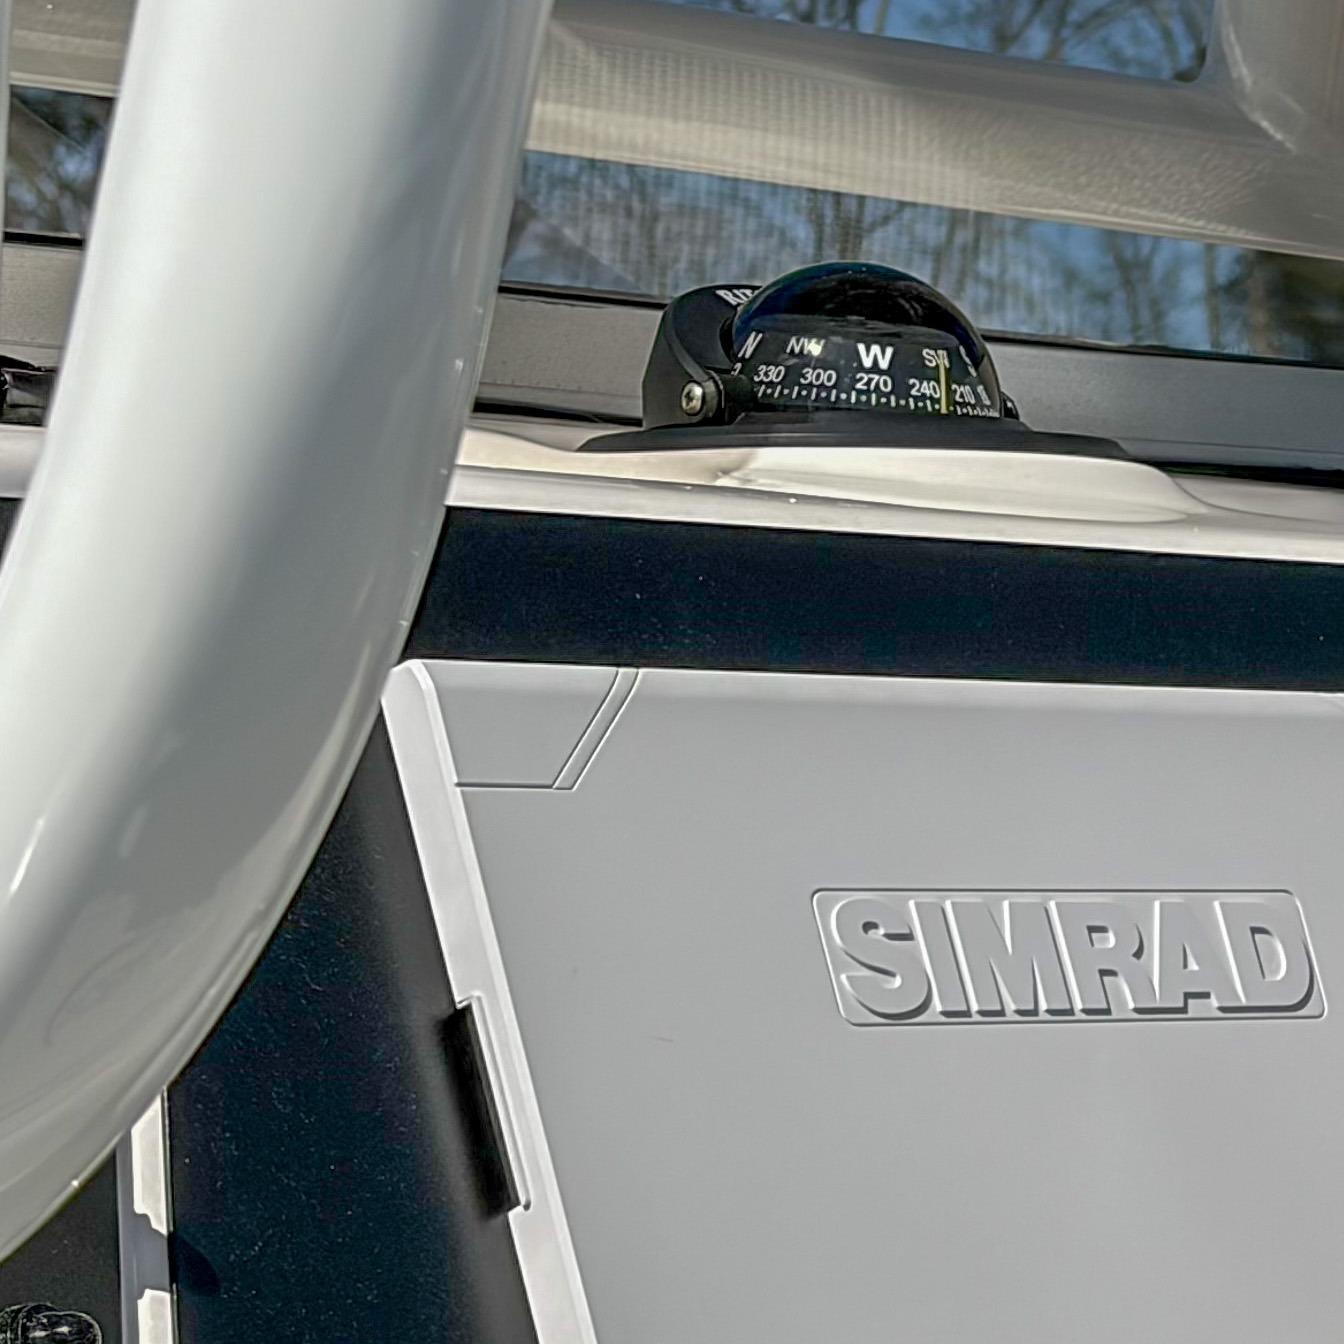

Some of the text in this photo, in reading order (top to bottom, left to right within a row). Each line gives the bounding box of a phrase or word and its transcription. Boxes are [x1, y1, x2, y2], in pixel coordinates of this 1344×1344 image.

[738, 331, 763, 359] N
[786, 336, 825, 357] NW
[856, 342, 894, 371] W
[753, 364, 785, 382] 330
[800, 367, 837, 387] 300
[855, 372, 892, 393] 270
[908, 378, 940, 398] 240
[951, 384, 975, 405] 210
[831, 899, 1314, 1020] SIMRAD
